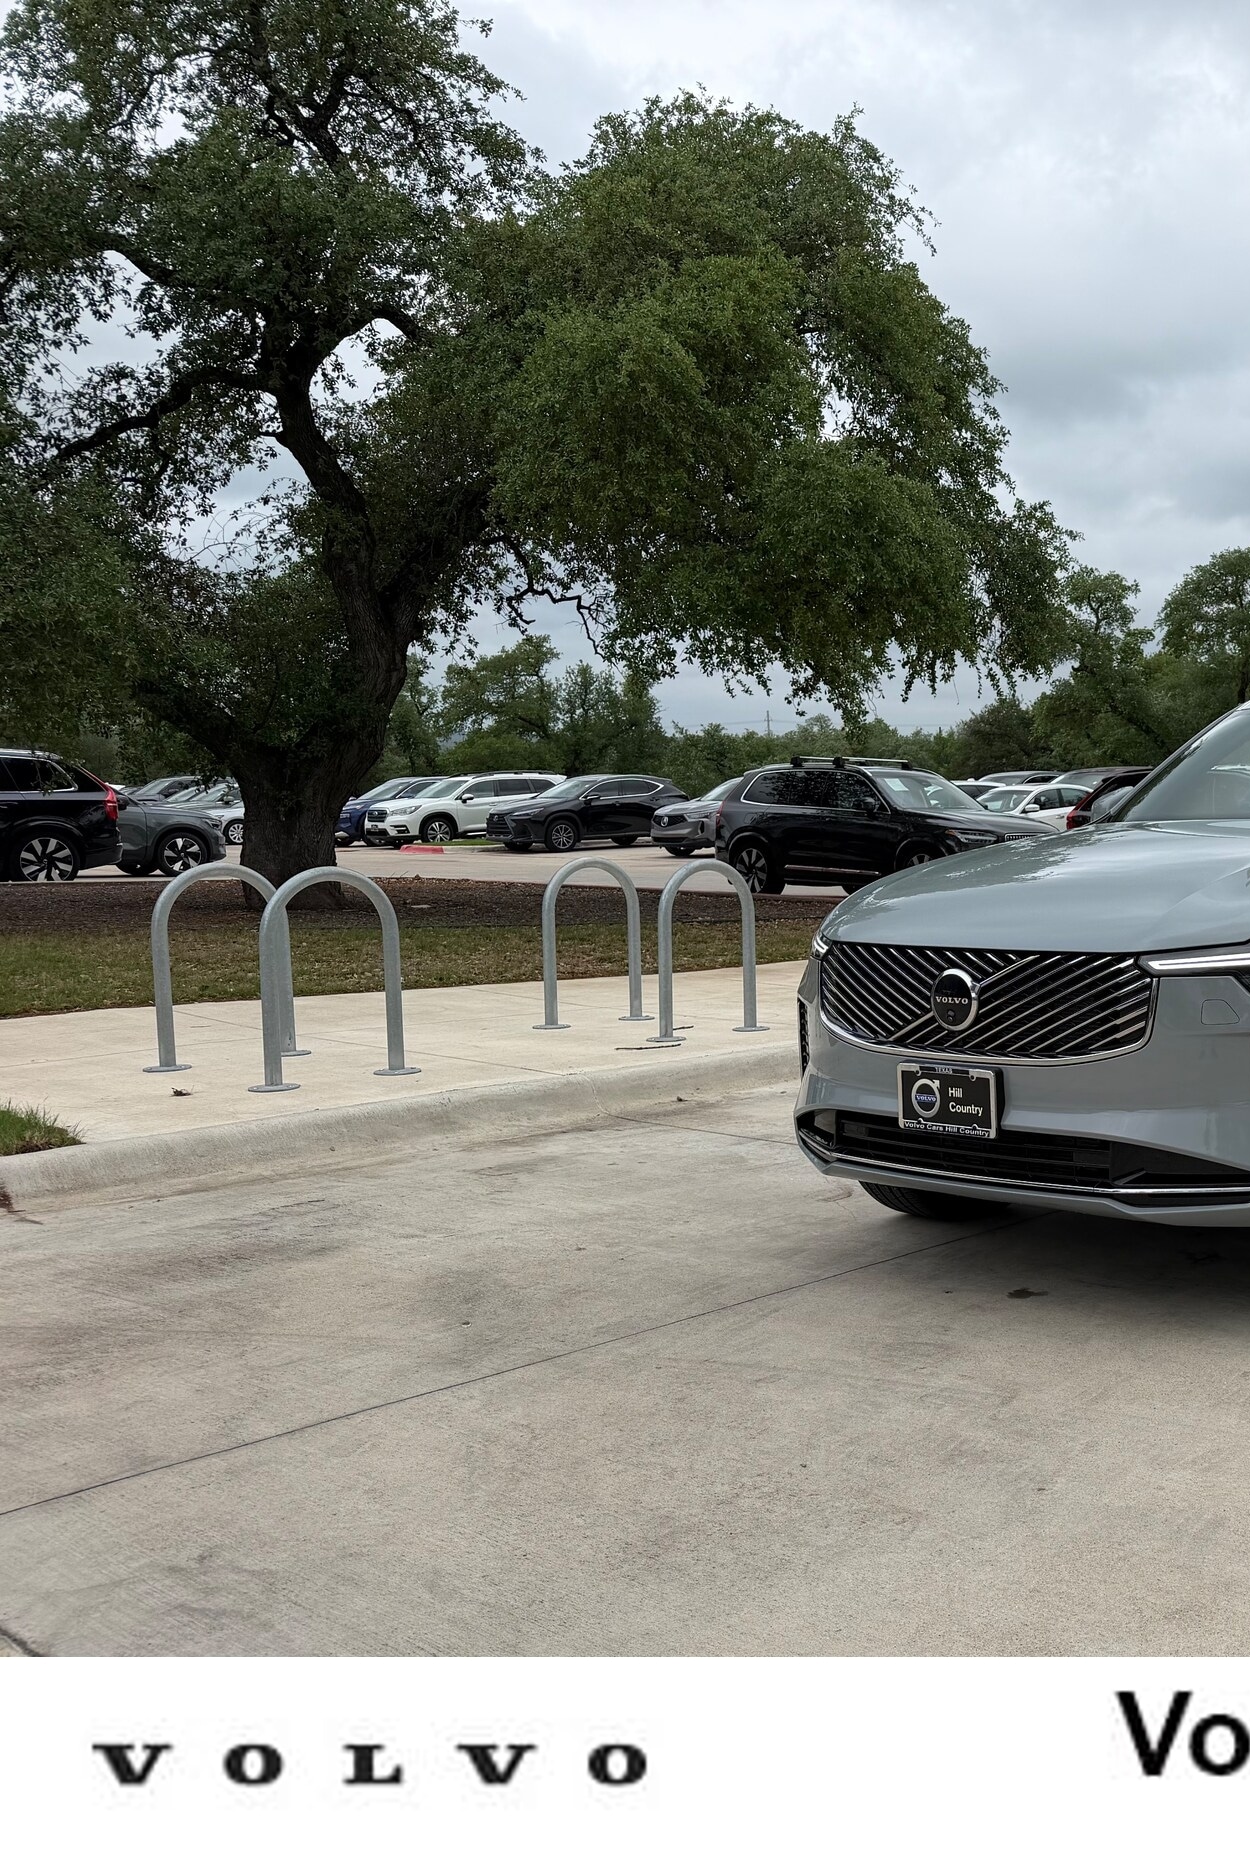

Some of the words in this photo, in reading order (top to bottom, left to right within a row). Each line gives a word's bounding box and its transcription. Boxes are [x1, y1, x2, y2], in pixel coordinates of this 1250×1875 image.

[935, 996, 969, 1005] VOLVO
[948, 1087, 963, 1098] Hill
[949, 1102, 983, 1116] Country
[904, 1121, 925, 1129] Volvo
[926, 1124, 944, 1132] Cars
[959, 1127, 990, 1137] Country
